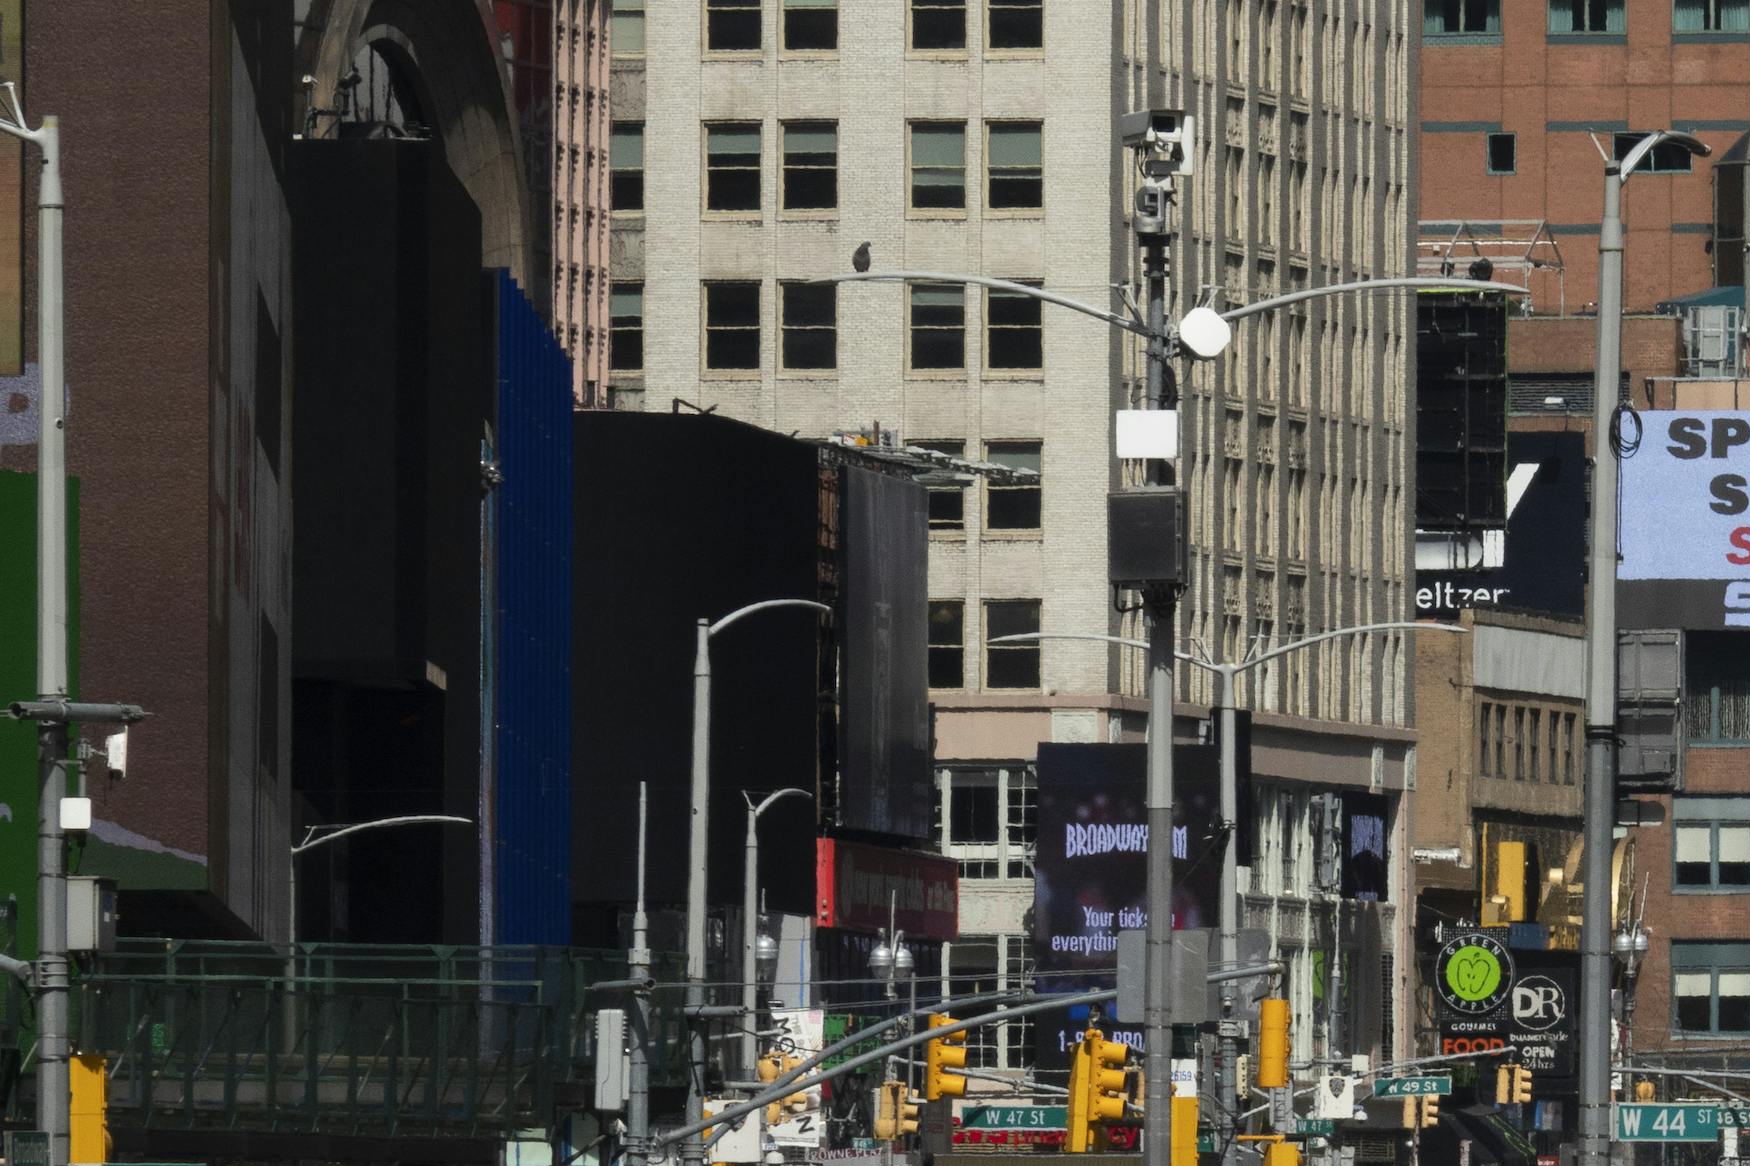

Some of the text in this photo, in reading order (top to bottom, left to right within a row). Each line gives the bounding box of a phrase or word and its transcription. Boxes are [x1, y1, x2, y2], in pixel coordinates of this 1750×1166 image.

[1416, 582, 1505, 609] eltzer
[1083, 906, 1115, 927] Your
[1446, 936, 1501, 956] GREEN
[1446, 993, 1500, 1010] APPLE
[1512, 986, 1566, 1018] DR
[1450, 1023, 1497, 1031] GOURMET
[1443, 1037, 1505, 1056] FOOD
[1522, 1046, 1555, 1059] OPEN
[1387, 1081, 1437, 1094] W 49 St
[986, 1110, 1045, 1126] W 47 St
[1298, 1120, 1307, 1131] W
[1622, 1108, 1713, 1137] W 44 ST
